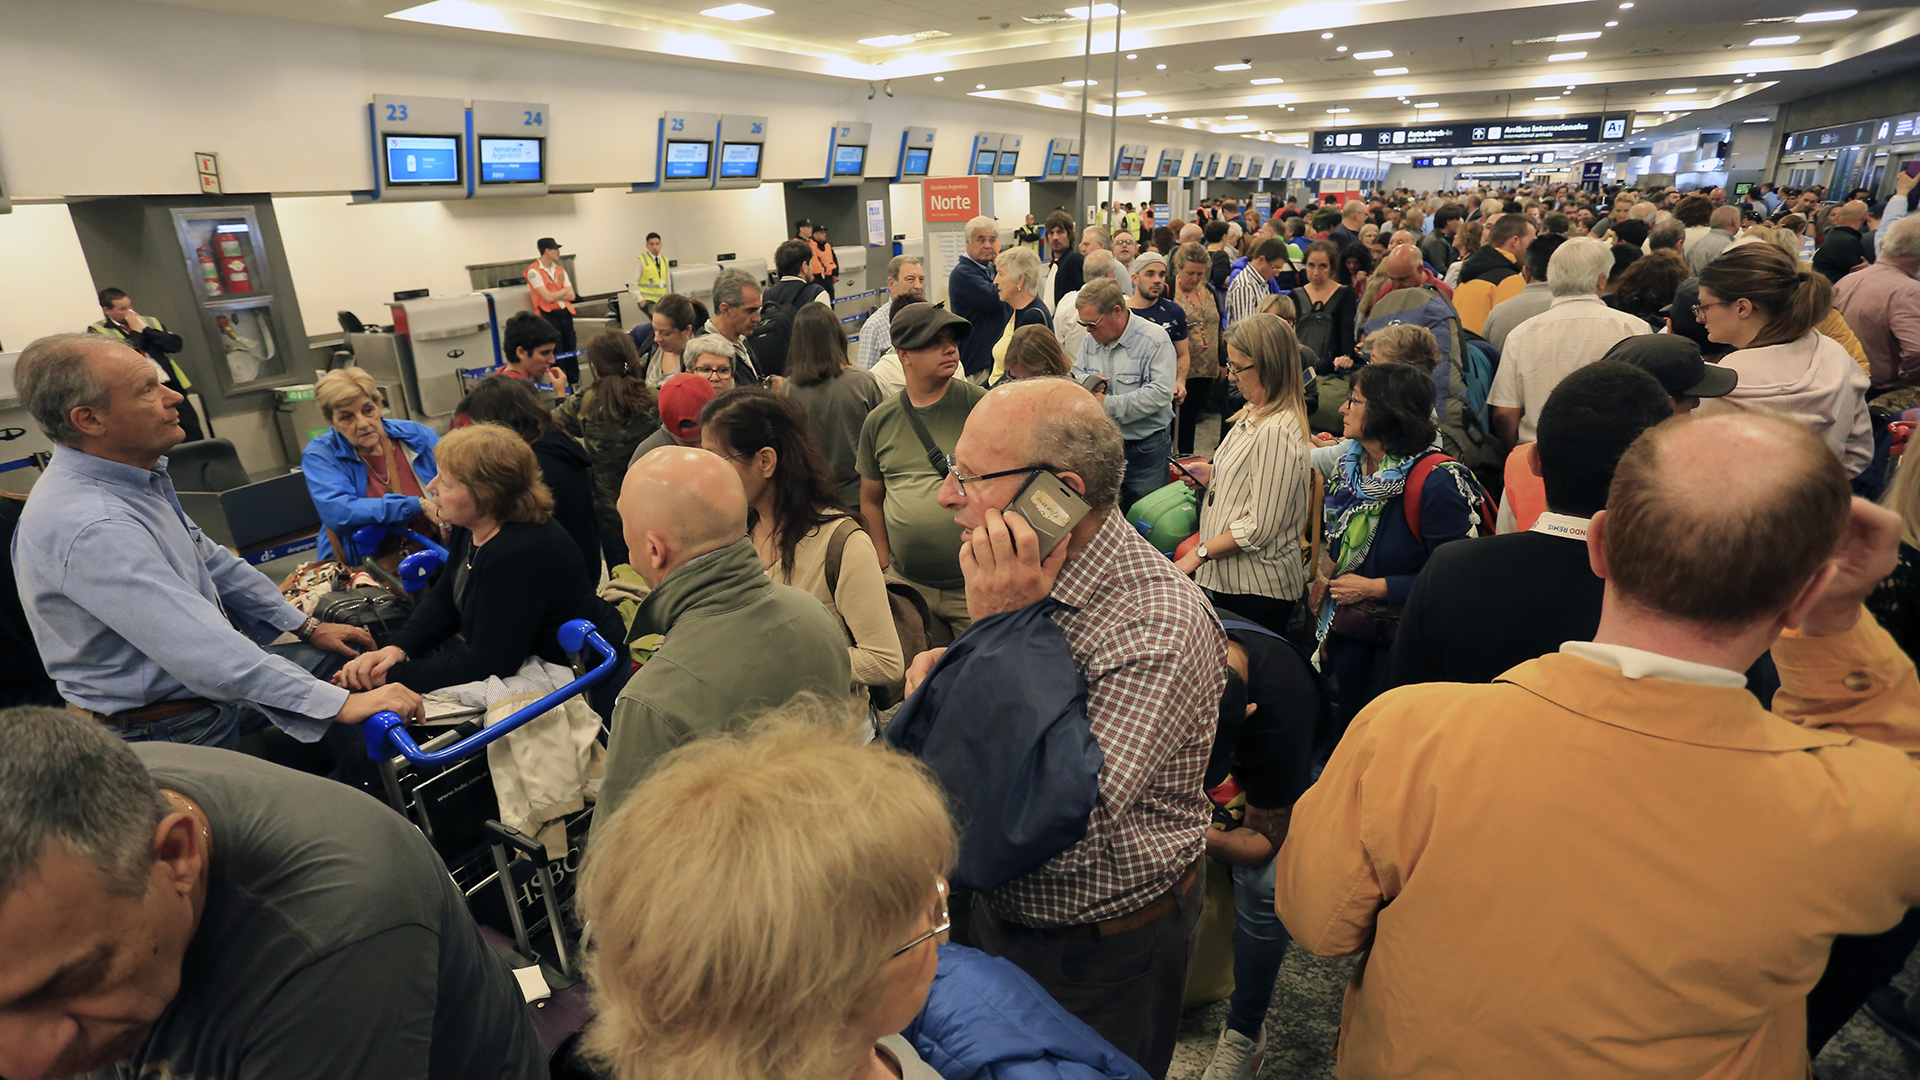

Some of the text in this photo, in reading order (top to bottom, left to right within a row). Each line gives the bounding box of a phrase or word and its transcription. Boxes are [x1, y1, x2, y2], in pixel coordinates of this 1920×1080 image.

[386, 104, 408, 120] 23
[523, 110, 543, 126] 24
[671, 118, 684, 131] 25
[750, 122, 763, 134] 26
[1504, 126, 1531, 134] Arribos
[1608, 122, 1621, 133] A1
[841, 127, 850, 137] 27
[930, 195, 971, 210] Norte
[1548, 524, 1568, 533] REMIS
